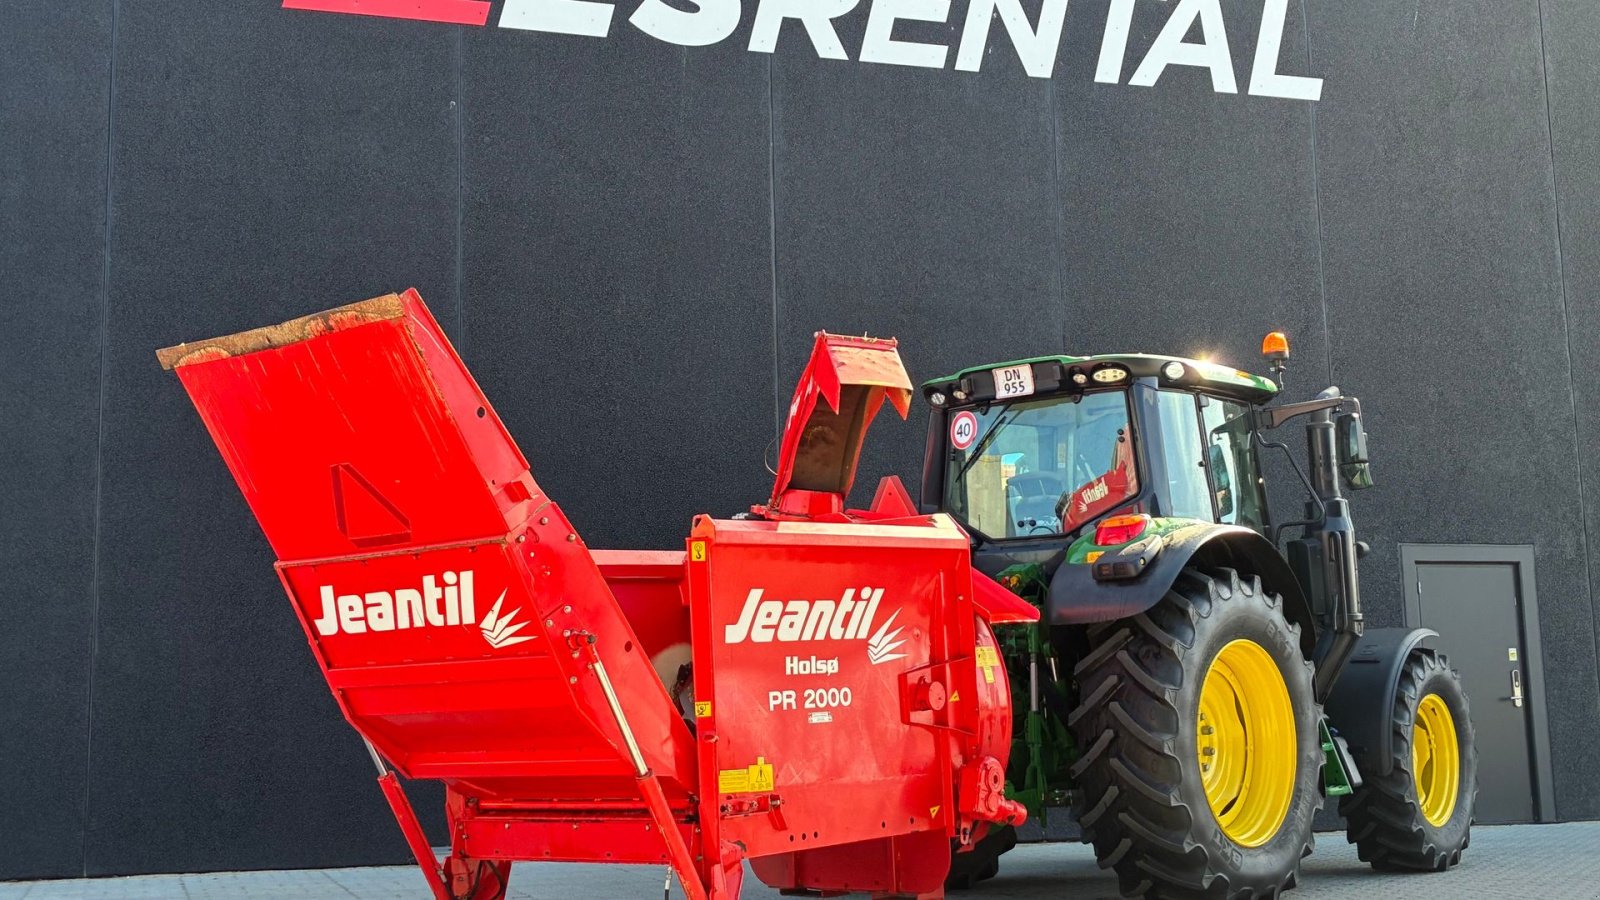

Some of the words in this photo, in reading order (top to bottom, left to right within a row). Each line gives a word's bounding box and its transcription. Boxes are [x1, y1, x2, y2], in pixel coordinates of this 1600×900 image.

[1004, 368, 1020, 382] DN
[1004, 381, 1025, 394] 955
[956, 423, 971, 437] 40
[314, 570, 475, 636] Jeantil
[725, 587, 885, 644] Jeantil
[785, 656, 839, 676] Holsø
[768, 690, 797, 711] PR
[804, 687, 852, 709] 2000
